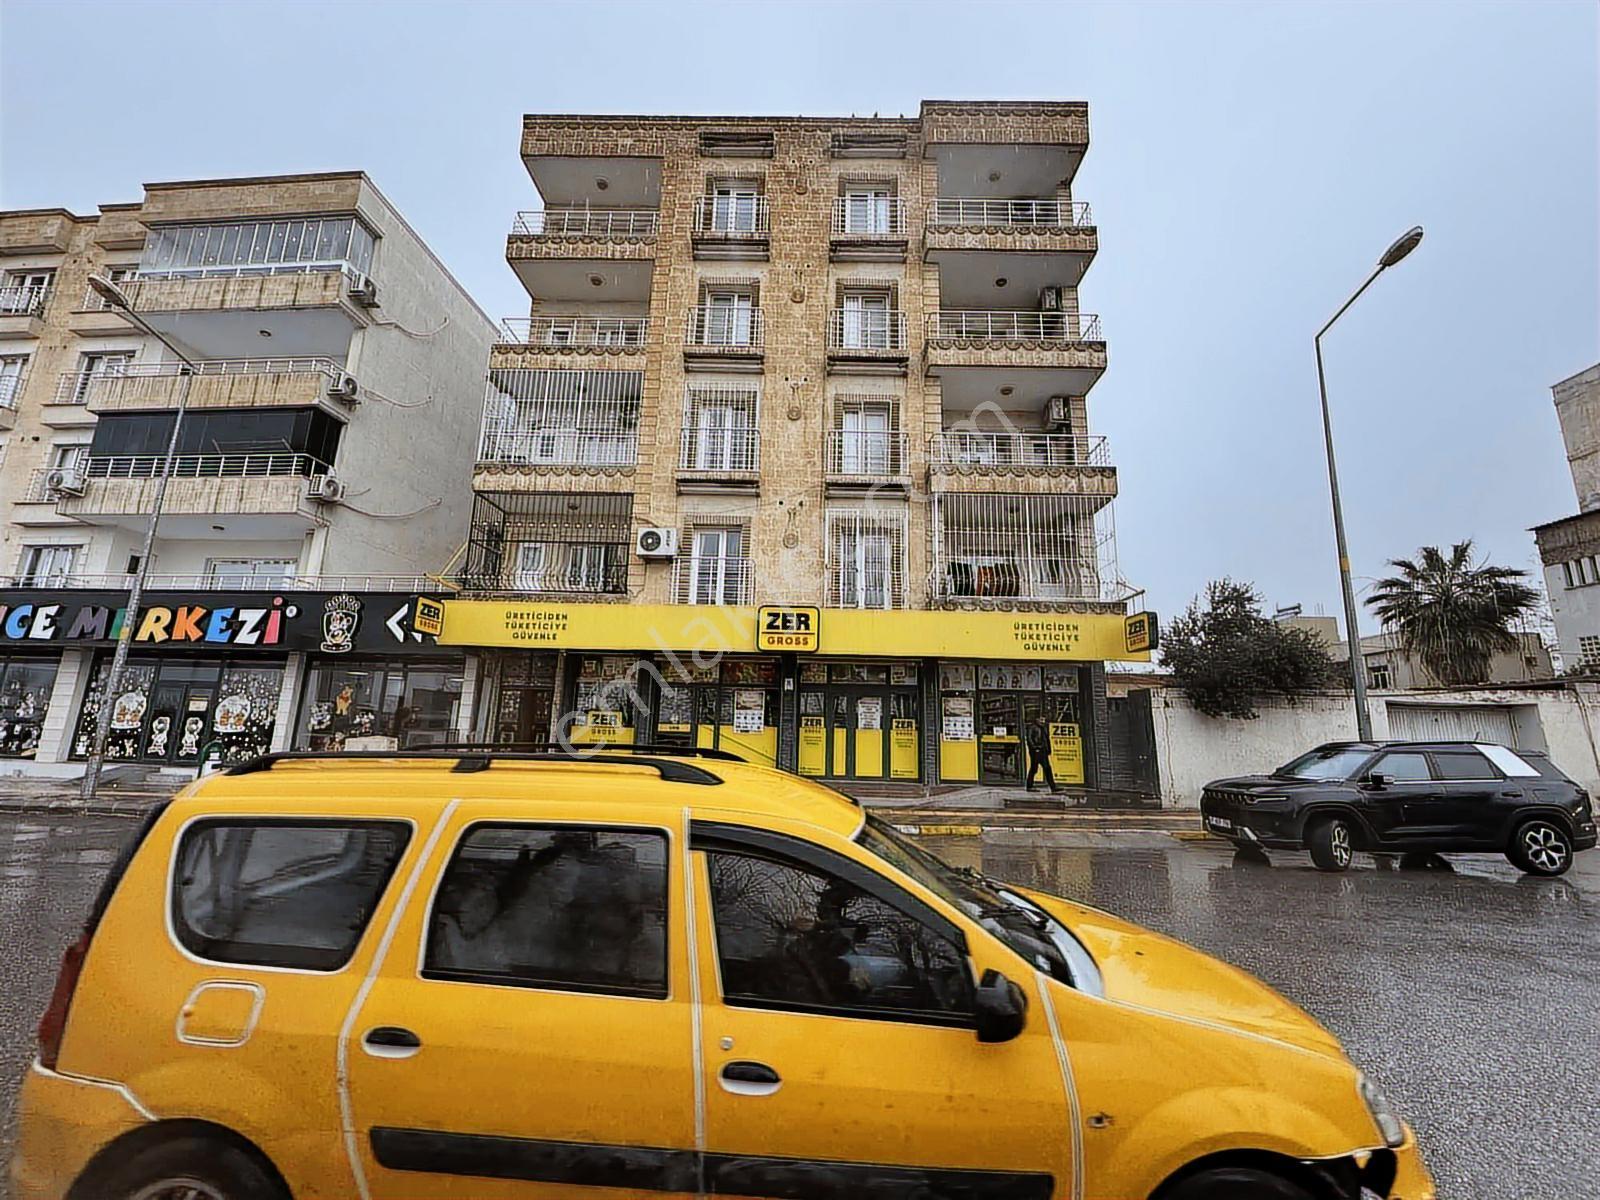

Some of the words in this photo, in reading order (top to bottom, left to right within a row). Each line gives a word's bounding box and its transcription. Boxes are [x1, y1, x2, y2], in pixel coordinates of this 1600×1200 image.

[420, 603, 441, 620] ZER
[505, 611, 568, 621] ÜRETİCİDEN
[0, 604, 60, 640] CE
[505, 621, 568, 631] TÜKETİCİYE
[766, 612, 810, 631] ZER
[1013, 621, 1079, 632] ÜRETİCİDEN
[1128, 620, 1146, 636] ZER
[512, 631, 558, 641] GÜVENLE
[767, 636, 809, 646] GROSS
[1014, 632, 1079, 642] TÜKETİCİYE
[1023, 642, 1071, 652] GÜVENLE
[591, 713, 617, 726] ZER
[1052, 725, 1076, 736] ZER
